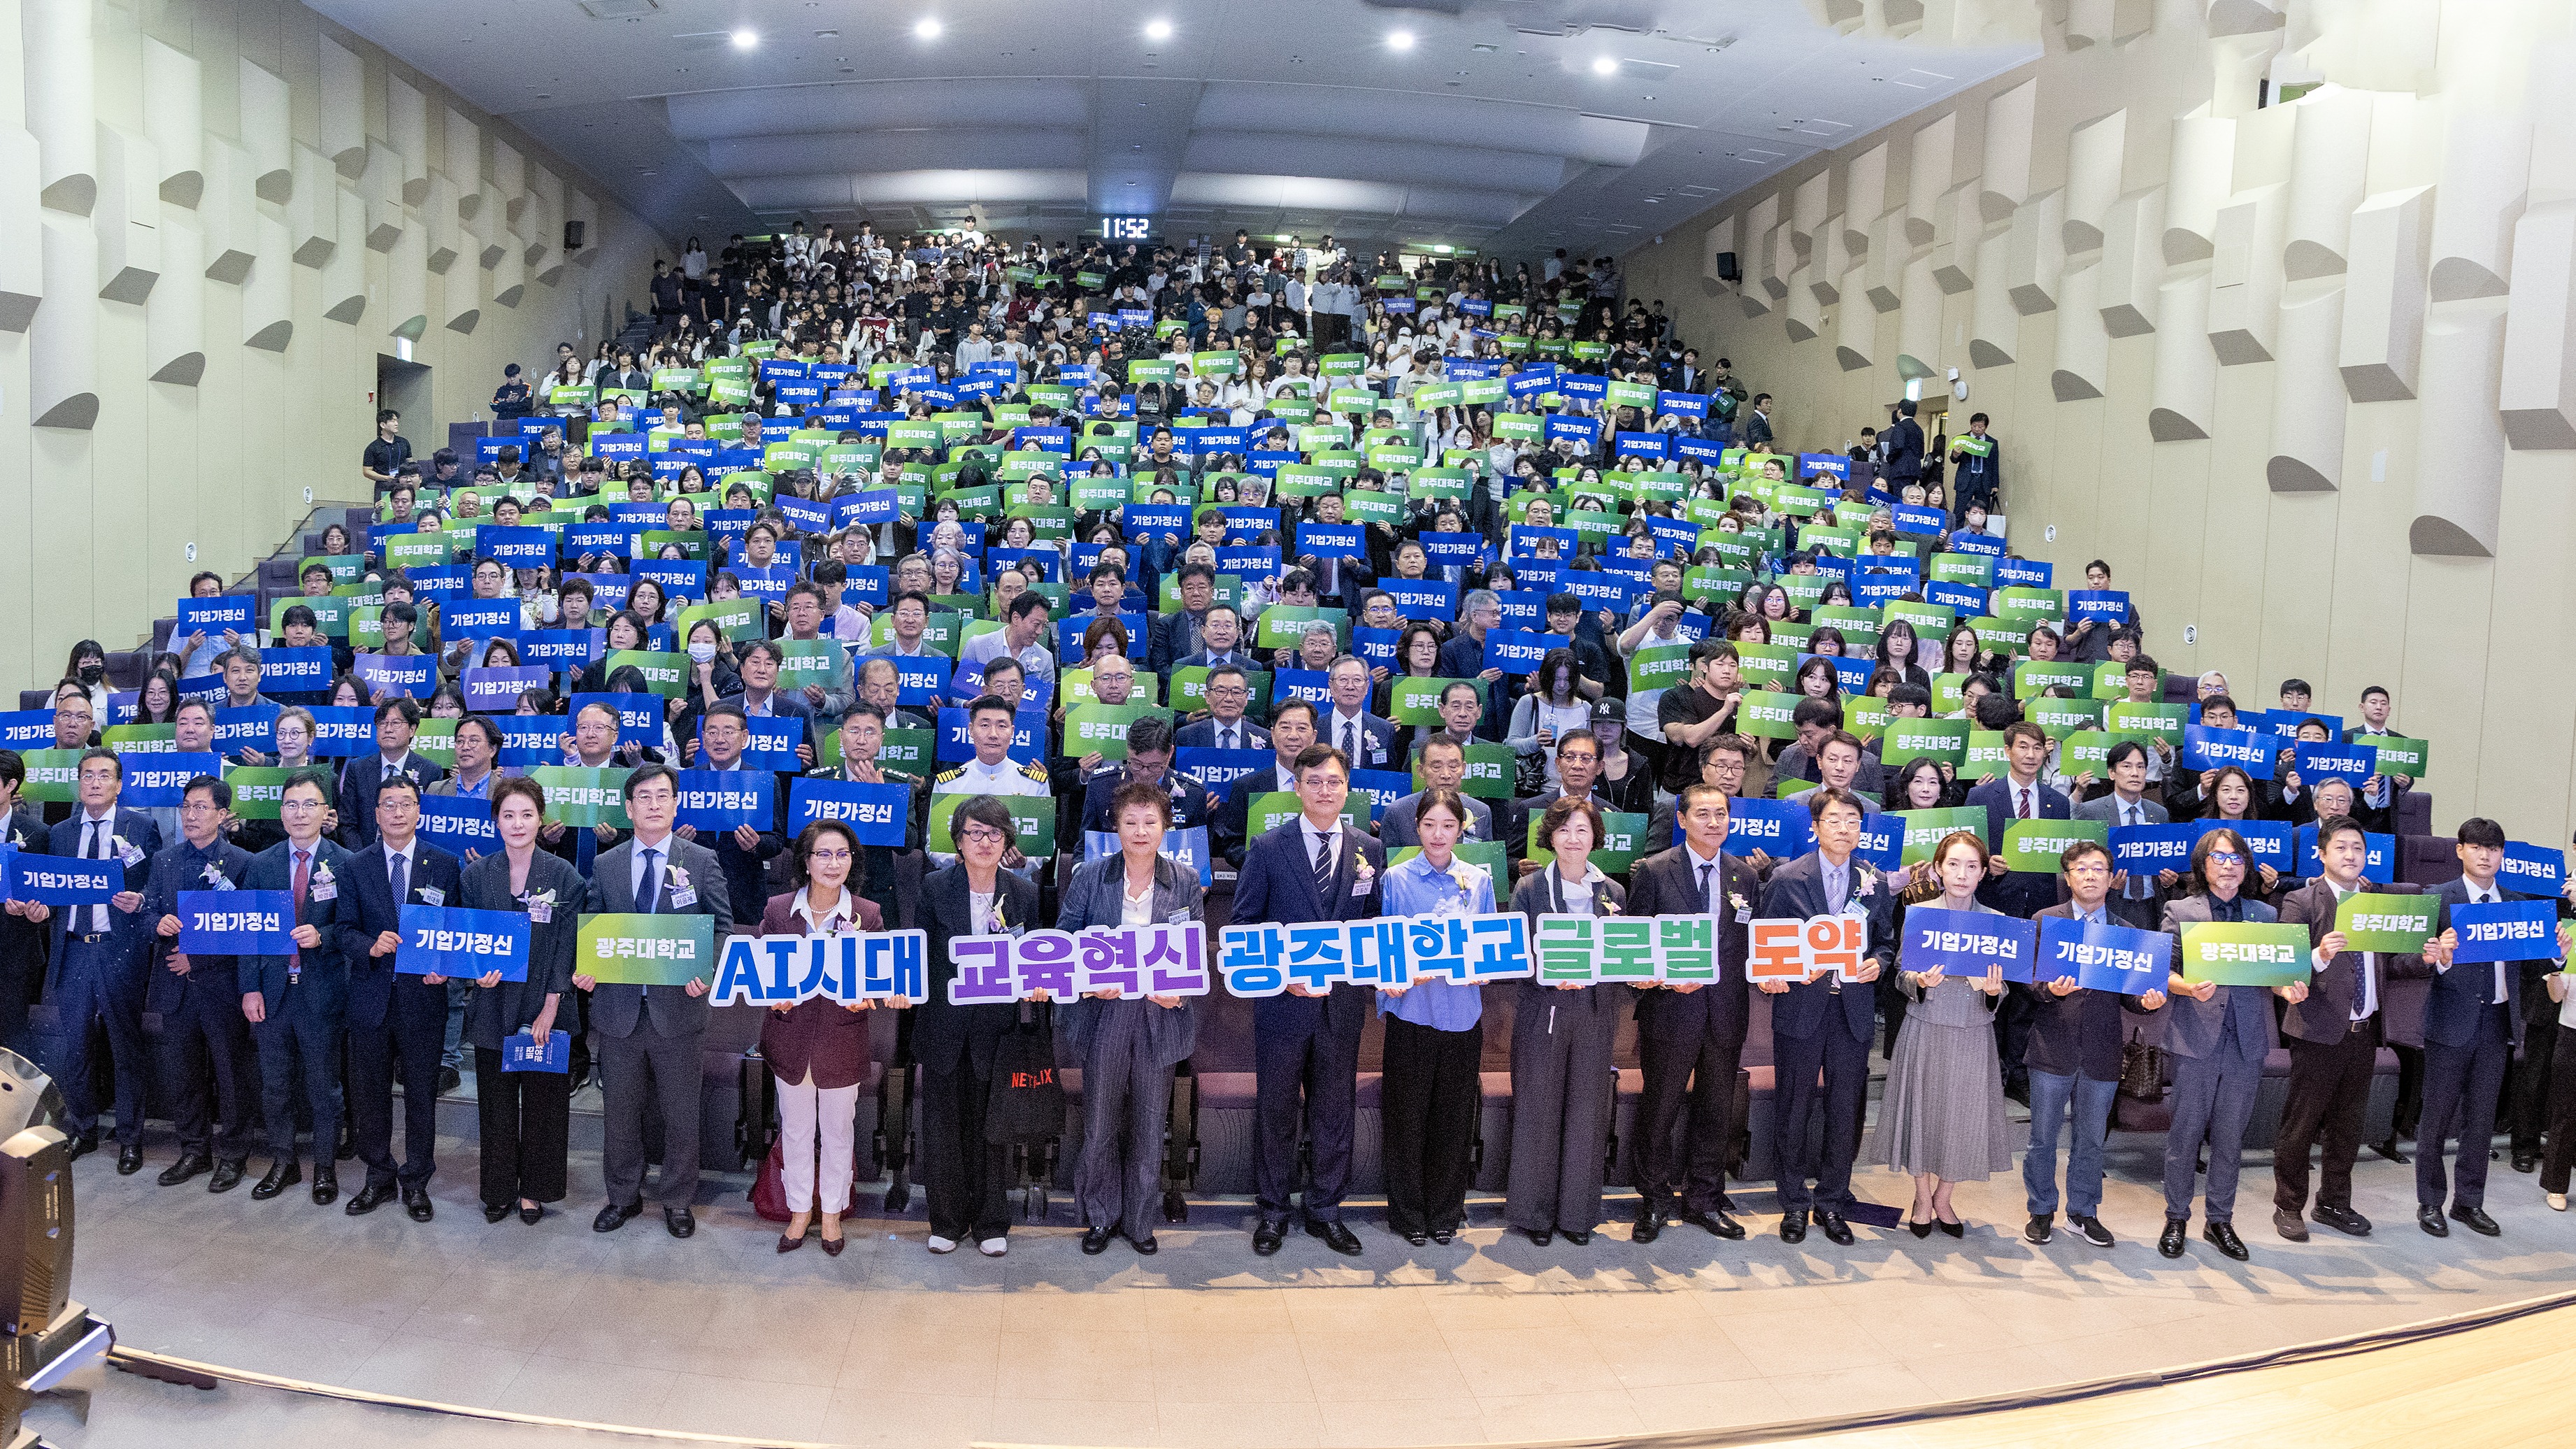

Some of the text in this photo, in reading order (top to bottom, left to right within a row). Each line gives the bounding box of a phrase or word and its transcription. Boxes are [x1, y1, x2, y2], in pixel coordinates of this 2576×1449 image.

[1102, 217, 1149, 238] 11:52
[1198, 358, 1233, 367] 광주대학교
[767, 367, 802, 377] 기업가정신
[895, 375, 931, 387] 기업가정신
[958, 380, 994, 393] 기업가정신
[1515, 376, 1551, 390] 기업가정신
[1565, 382, 1601, 392] 기업가정신
[1031, 392, 1068, 401] 광주대학교
[1421, 390, 1458, 402] 광주대학교
[1466, 385, 1504, 397] 광주대학교
[1614, 389, 1650, 399] 광주대학교
[1337, 396, 1373, 406] 광주대학교
[1664, 399, 1702, 410] 기업가정신
[1272, 408, 1310, 417] 광주대학교
[1501, 422, 1539, 432] 광주대학교
[1553, 422, 1591, 434] 기업가정신
[895, 429, 936, 439] 광주대학교
[1305, 434, 1344, 443] 광주대학교
[1199, 436, 1240, 445] 기업가정신
[1623, 440, 1661, 450] 기업가정신
[600, 443, 642, 452] 기업가정신
[1680, 445, 1717, 457] 기업가정신
[770, 452, 810, 462] 광주대학교
[830, 454, 873, 463] 광주대학교
[1377, 454, 1417, 464] 광주대학교
[1010, 462, 1054, 471] 광주대학교
[1807, 461, 1845, 472] 기업가정신
[1285, 475, 1333, 487] 광주대학교
[1419, 478, 1465, 489] 광주대학교
[1640, 481, 1684, 492] 광주대학교
[1079, 488, 1126, 499] 광주대학교
[1350, 500, 1397, 513] 광주대학교
[1778, 494, 1819, 508] 광주대학교
[841, 500, 890, 516] 기업가정신
[617, 513, 665, 524] 기업가정신
[782, 506, 827, 523] 기업가정신
[1133, 515, 1182, 526] 기업가정신
[1898, 513, 1940, 526] 기업가정신
[1225, 518, 1273, 529] 기업가정신
[1574, 521, 1620, 534] 광주대학교
[572, 534, 622, 545] 기업가정신
[1653, 526, 1696, 542] 기업가정신
[1305, 535, 1356, 546] 기업가정신
[1807, 534, 1852, 548] 광주대학교
[394, 545, 443, 555] 광주대학교
[494, 544, 545, 556] 기업가정신
[1428, 543, 1476, 554] 기업가정신
[1959, 542, 2000, 555] 기업가정신
[1223, 557, 1272, 569] 기업가정신
[1938, 563, 1984, 575] 광주대학교
[1865, 566, 1911, 575] 기업가정신
[1998, 569, 2045, 582] 기업가정신
[413, 577, 464, 590] 기업가정신
[1692, 578, 1743, 591] 광주대학교
[1564, 583, 1622, 599] 기업가정신
[1935, 592, 1980, 608] 기업가정신
[2008, 597, 2054, 609] 광주대학교
[2077, 600, 2124, 612] 기업가정신
[189, 609, 245, 622] 기업가정신
[1500, 604, 1536, 616] 가정신
[451, 612, 510, 626] 기업가정신
[1976, 629, 2026, 643] 광주대학교
[528, 643, 587, 657] 기업가정신
[260, 662, 320, 676] 기업가정신
[364, 669, 427, 683] 기업가정신
[2119, 716, 2177, 730] 광주대학교
[1897, 734, 1961, 750] 광주대학교
[2196, 740, 2264, 764] 기업가정신
[2307, 757, 2366, 773] 기업가정신
[805, 799, 892, 823] 기업가정신
[417, 815, 495, 838] 기업가정신
[2117, 841, 2187, 858] 기업가정신
[24, 871, 108, 889] 기업가정신
[194, 913, 280, 932] 기업가정신
[2352, 915, 2428, 932] 광주대학교
[2467, 920, 2545, 941] 기업가정신
[416, 929, 513, 955] 기업가정신
[596, 937, 695, 959] 광주대학교
[1922, 930, 2017, 959] 기업가정신
[715, 918, 1861, 999] AI시대 교육혁신 광주대학교 글로벌 도약
[2056, 940, 2153, 973] 기업가정신
[2201, 943, 2296, 964] 광주대학교
